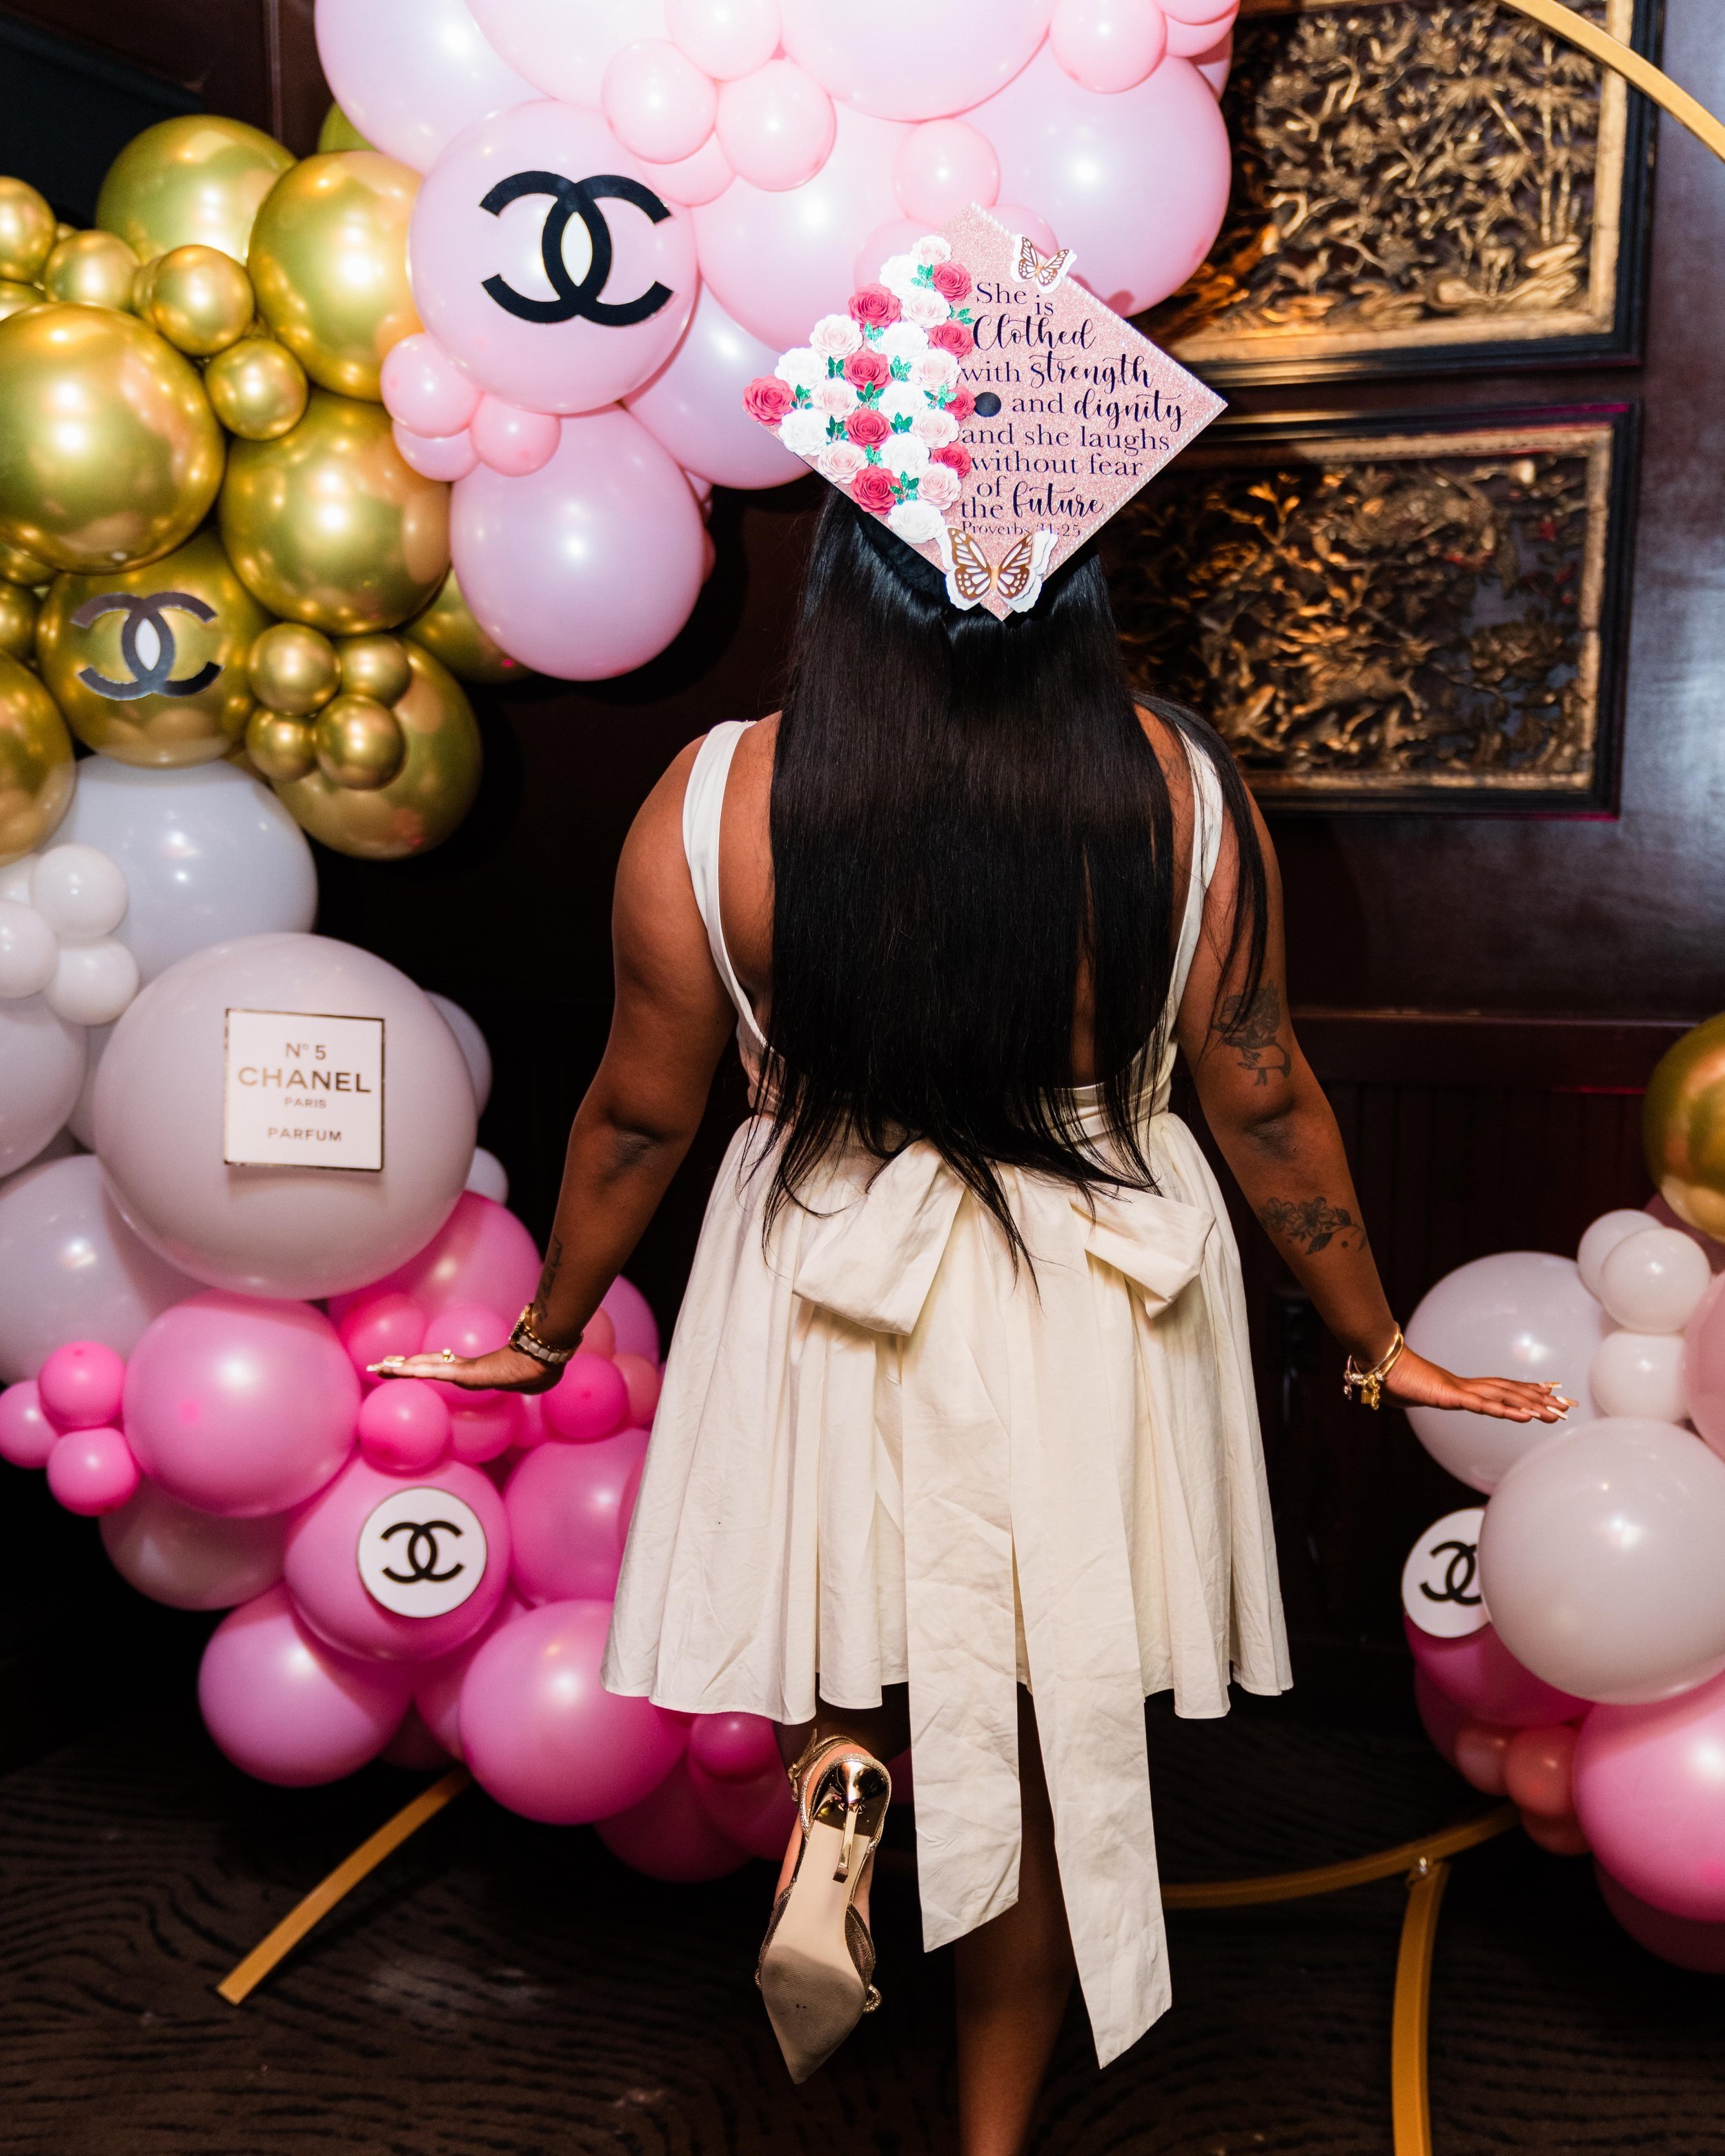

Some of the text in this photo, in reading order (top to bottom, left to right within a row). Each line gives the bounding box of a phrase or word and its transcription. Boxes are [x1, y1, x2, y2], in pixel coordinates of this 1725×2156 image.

[976, 281, 1054, 316] She is
[973, 313, 1096, 350] Clothed
[963, 361, 1021, 382] with
[1012, 388, 1187, 432] and dignity
[962, 423, 1170, 457] and she laughs
[972, 450, 1143, 476] without fear
[976, 475, 1007, 497] of
[961, 481, 1104, 520] the future
[962, 520, 1030, 537] Proverbs
[315, 1045, 327, 1060] 5
[238, 1066, 373, 1094] CHANEL
[284, 1098, 328, 1109] PARIS
[267, 1127, 343, 1143] PARFUM
